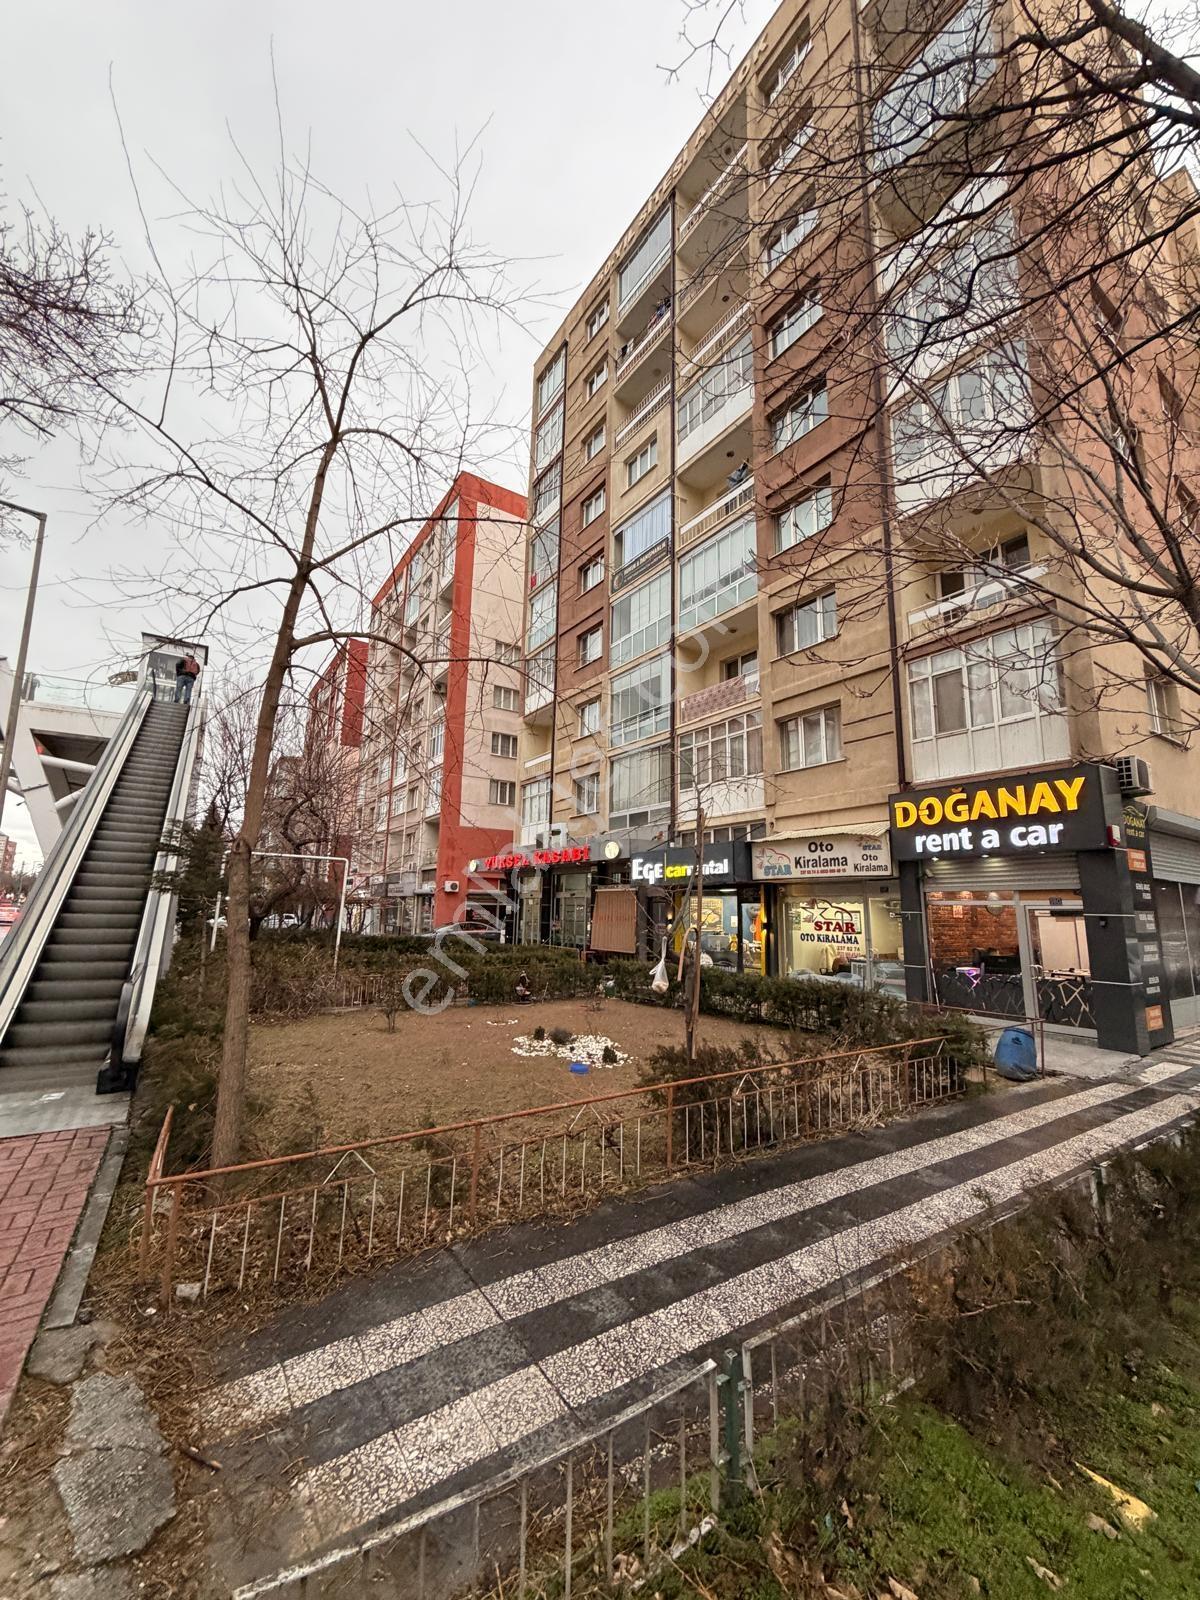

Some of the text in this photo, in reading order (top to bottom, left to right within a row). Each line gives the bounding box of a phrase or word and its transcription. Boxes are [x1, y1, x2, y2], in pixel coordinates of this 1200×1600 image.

[694, 126, 707, 149] A
[713, 33, 769, 120] BLOK
[894, 777, 1086, 828] DOĞANAY
[915, 822, 1064, 853] rent a car
[808, 841, 834, 853] Oto
[794, 855, 849, 869] Kiralama
[861, 853, 879, 862] Oto
[764, 864, 792, 876] STAR
[853, 863, 889, 872] Kiralama
[814, 920, 856, 933] STAR
[800, 933, 815, 942] OTO
